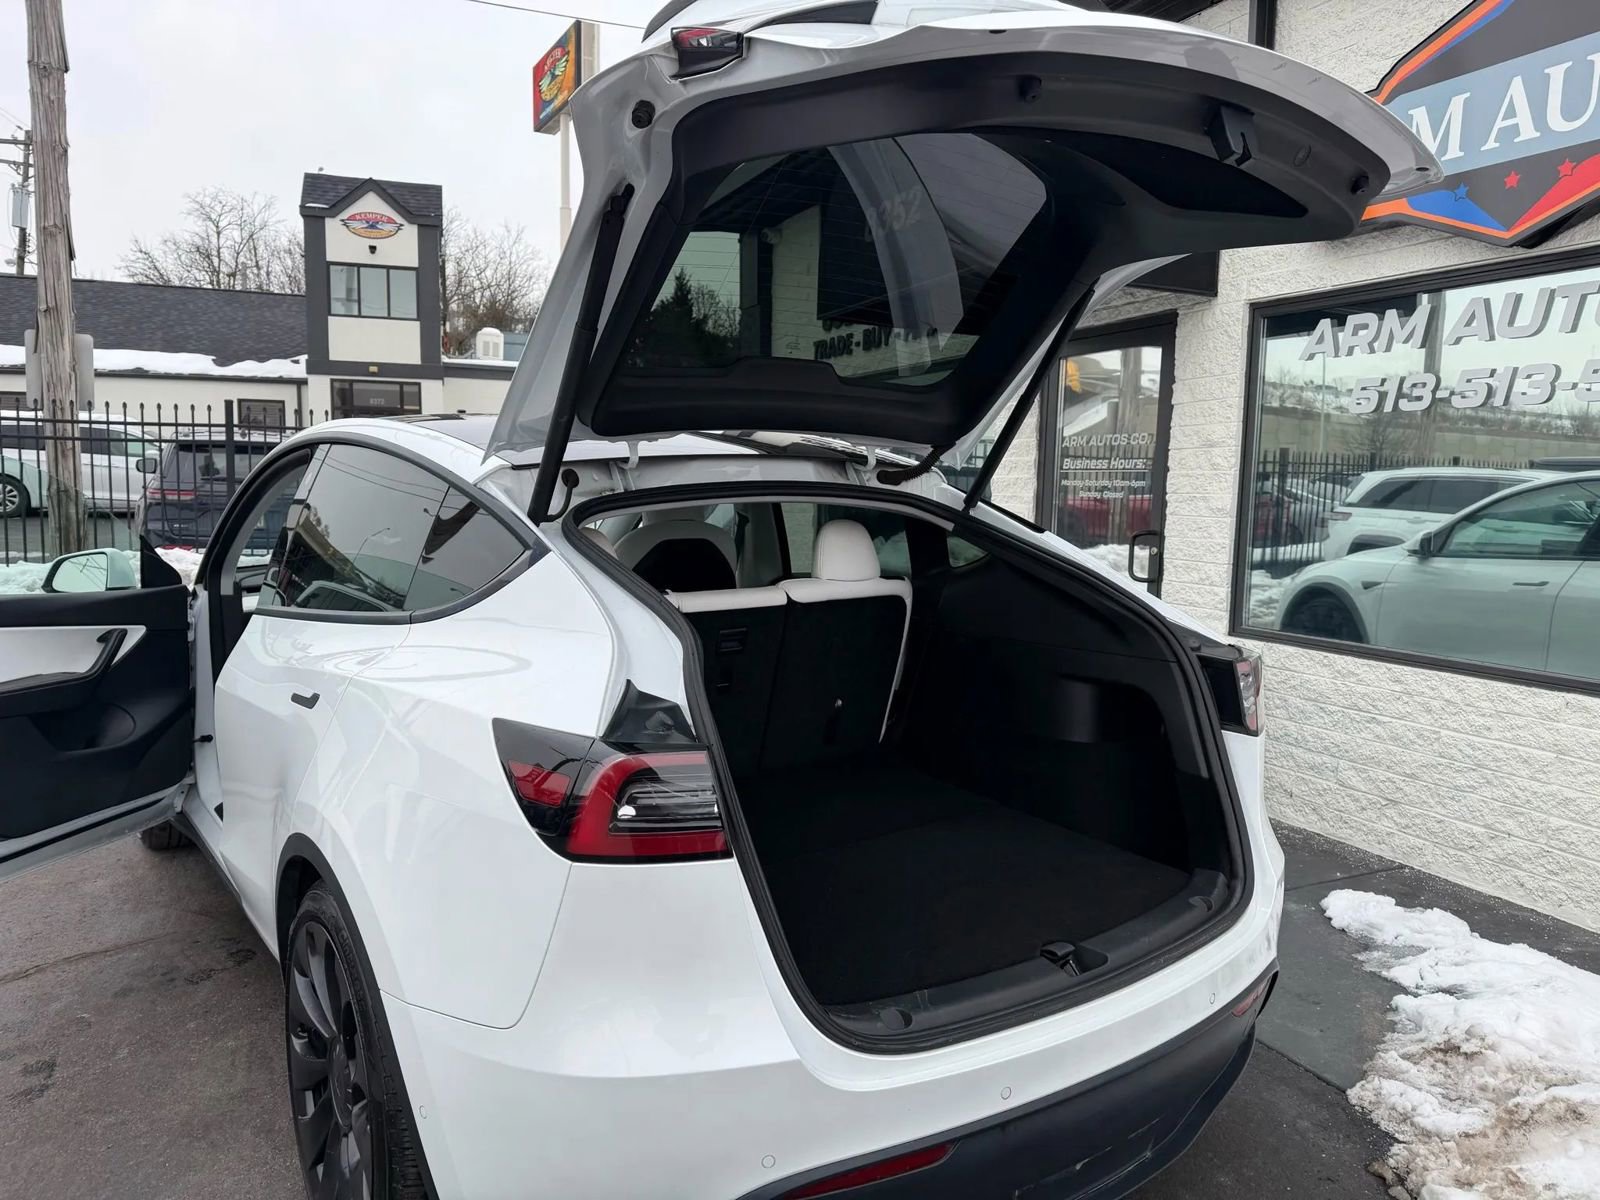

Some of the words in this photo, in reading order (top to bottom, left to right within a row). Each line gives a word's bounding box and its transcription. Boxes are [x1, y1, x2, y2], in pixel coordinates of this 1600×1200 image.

[1299, 304, 1434, 361] ARM
[1444, 280, 1600, 346] AUT
[1062, 435, 1086, 447] ARM
[1089, 433, 1128, 446] AUTOS
[1062, 457, 1108, 469] Business
[1110, 457, 1146, 469] Hours:
